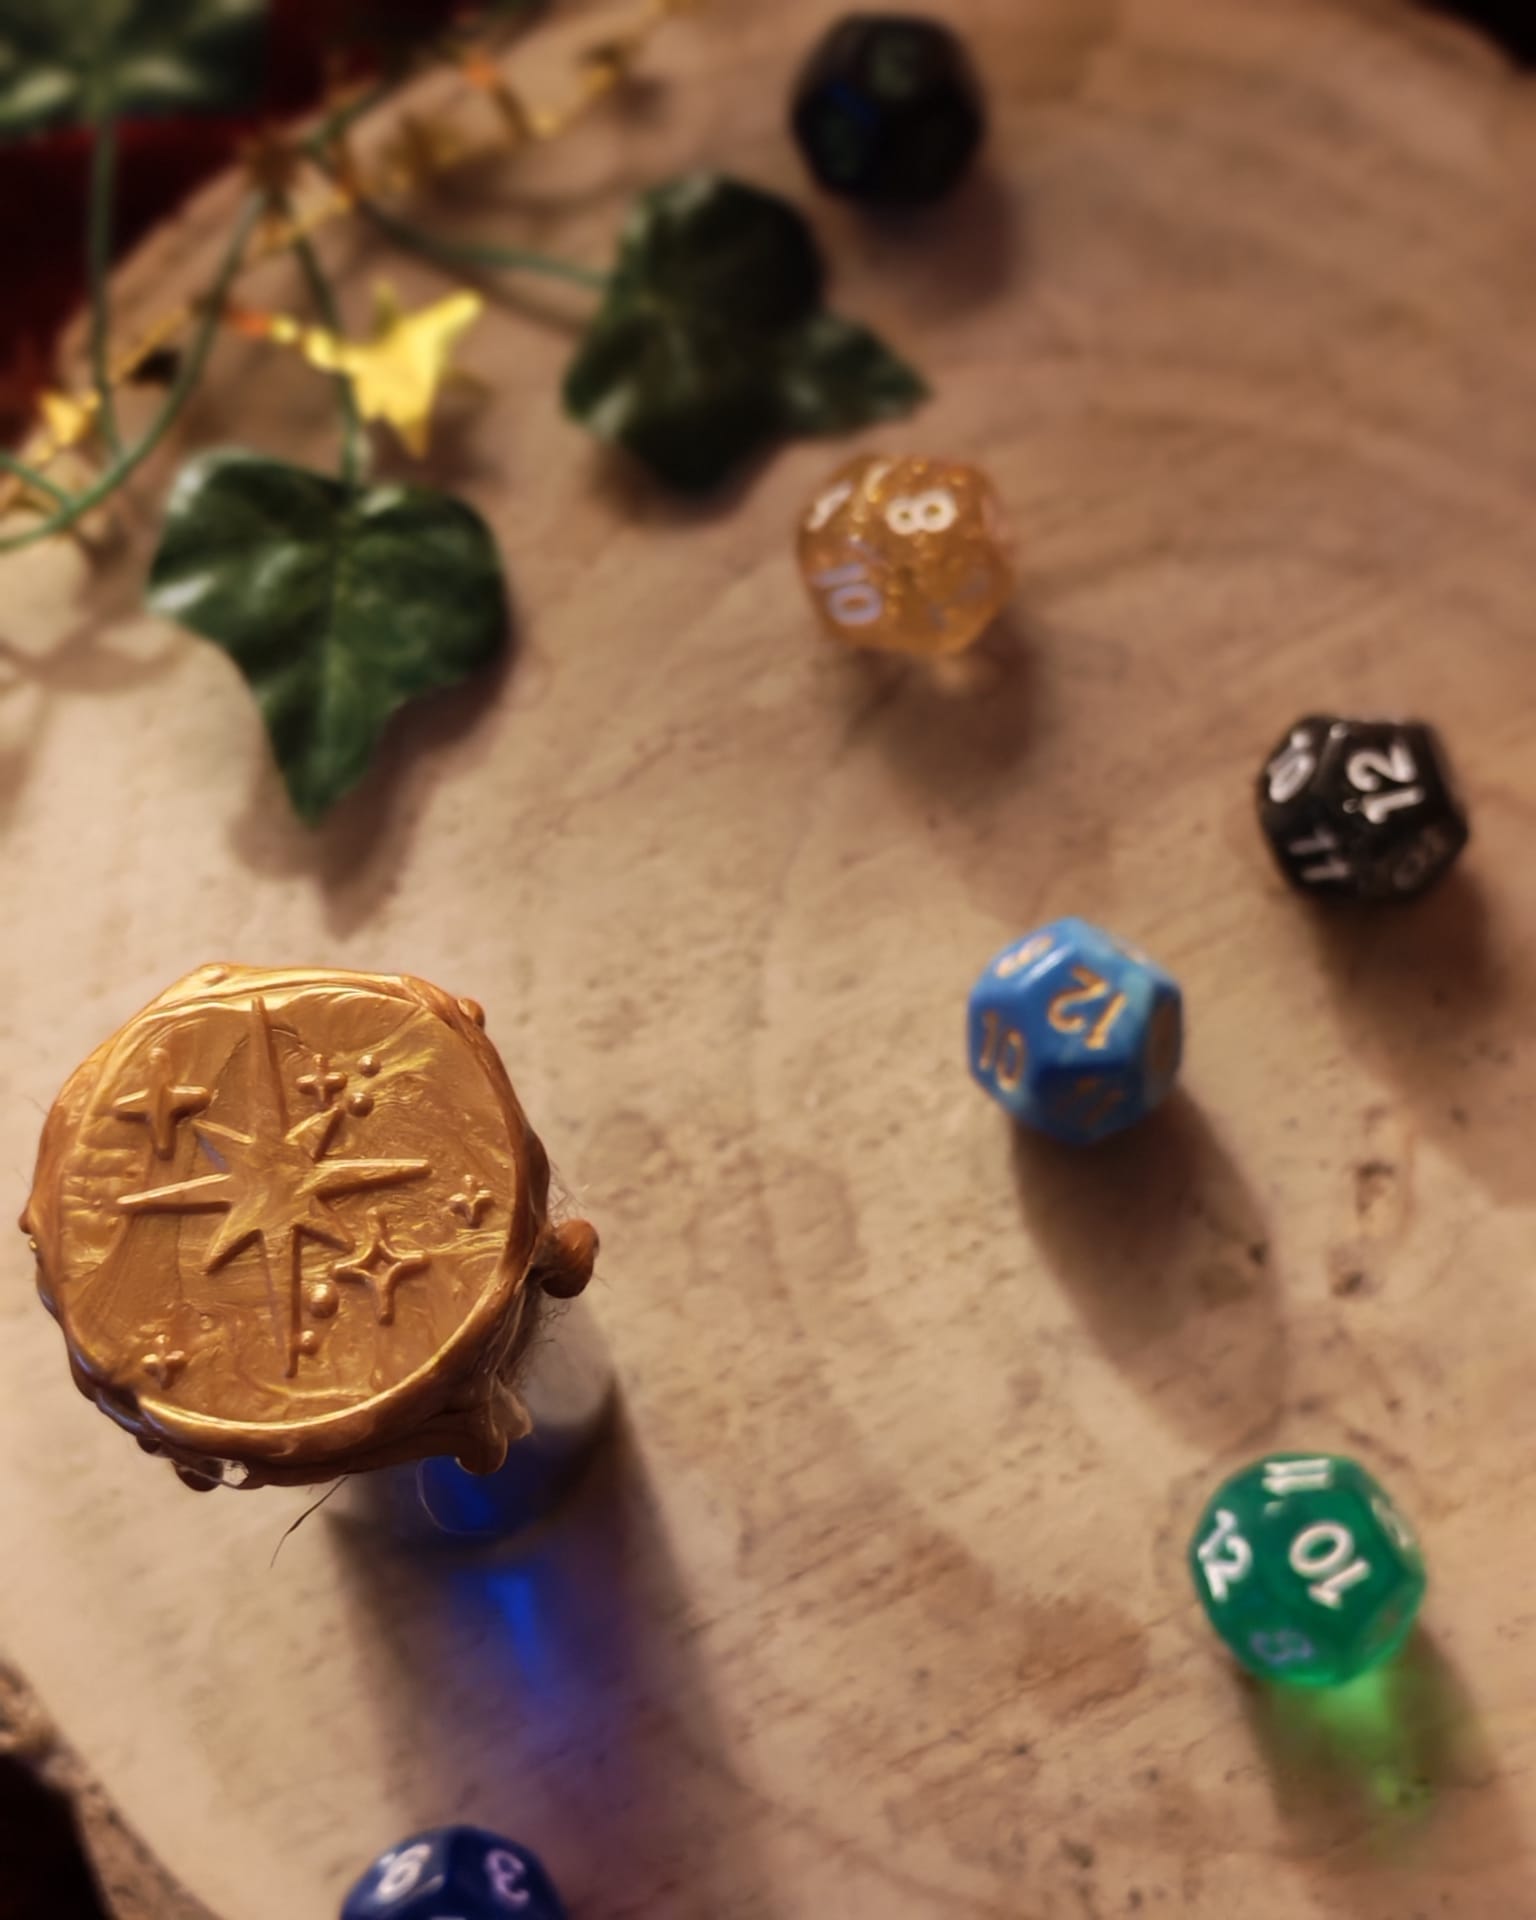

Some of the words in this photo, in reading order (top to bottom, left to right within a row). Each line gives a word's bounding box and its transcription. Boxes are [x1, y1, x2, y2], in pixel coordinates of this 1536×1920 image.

[886, 488, 958, 535] 8
[813, 562, 883, 627] 10
[1346, 738, 1425, 825] 12
[1047, 965, 1128, 1050] 12
[1261, 1457, 1333, 1496] 11
[1198, 1508, 1253, 1602] 12
[1288, 1518, 1371, 1610] 10
